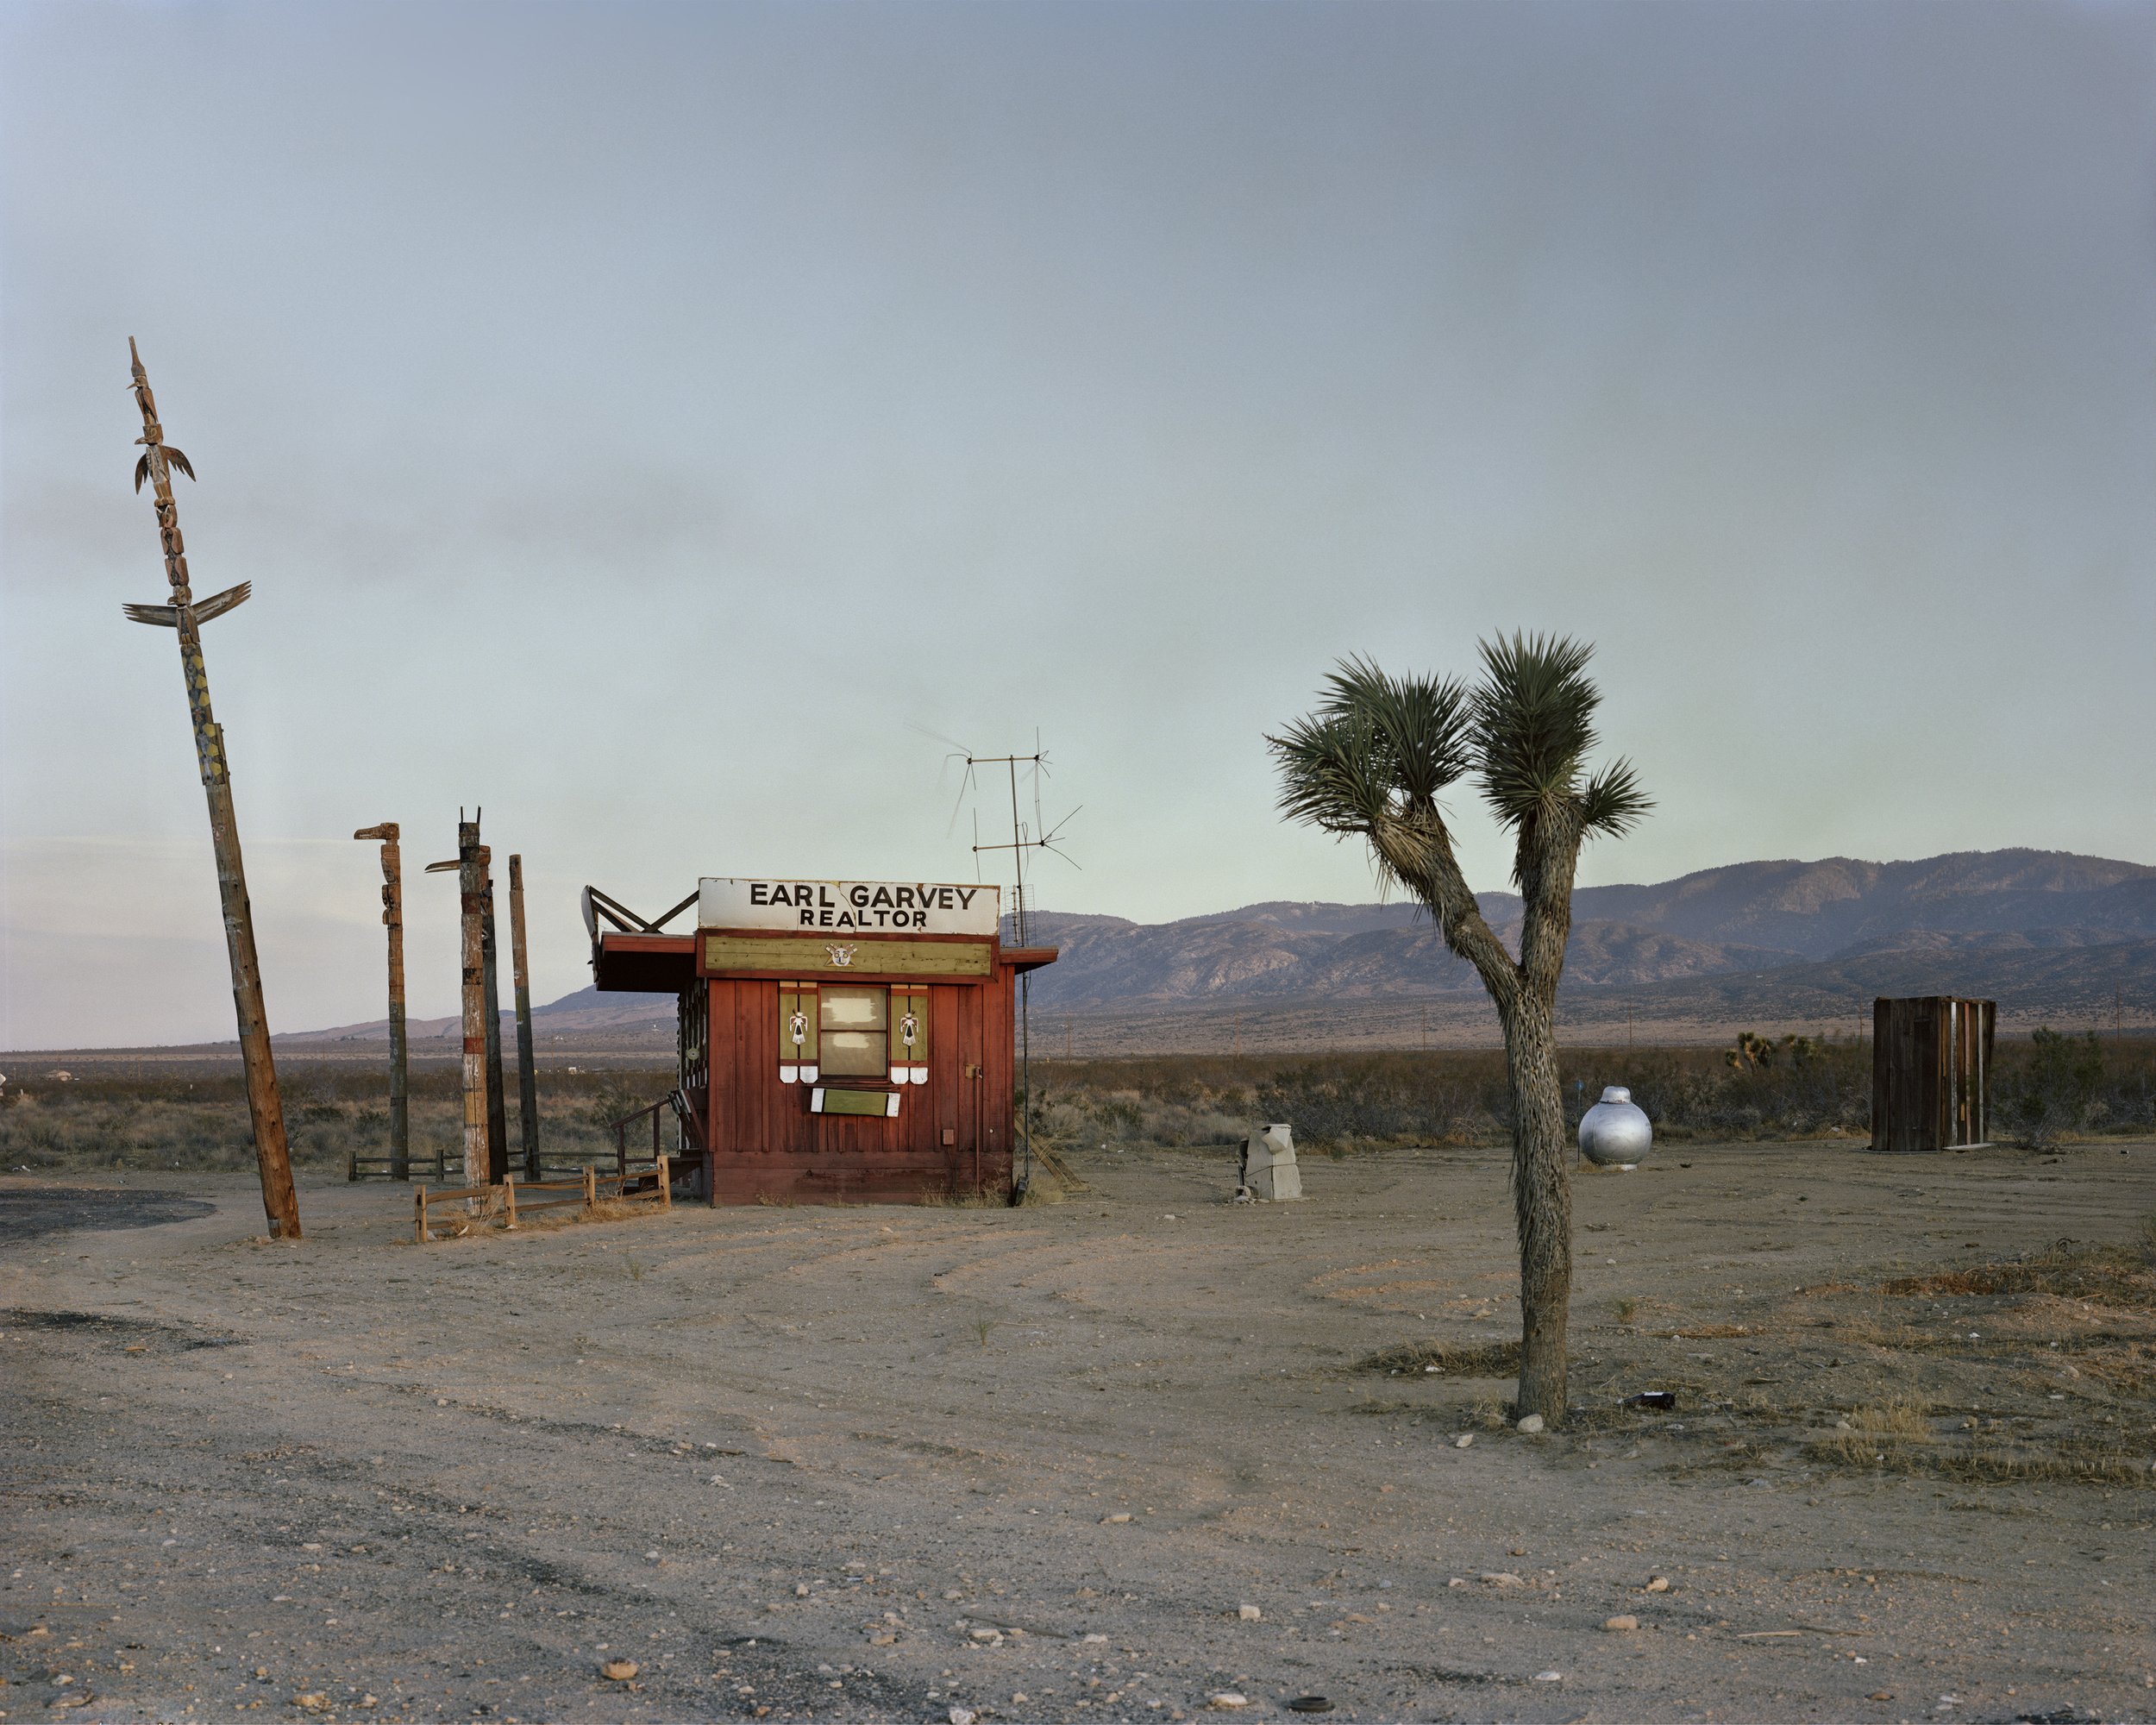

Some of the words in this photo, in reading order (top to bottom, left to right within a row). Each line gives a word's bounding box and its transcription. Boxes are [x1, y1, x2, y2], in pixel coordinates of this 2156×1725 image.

[750, 883, 835, 907] EARL
[850, 885, 976, 910] GARVEY
[800, 909, 927, 927] REALTOR
